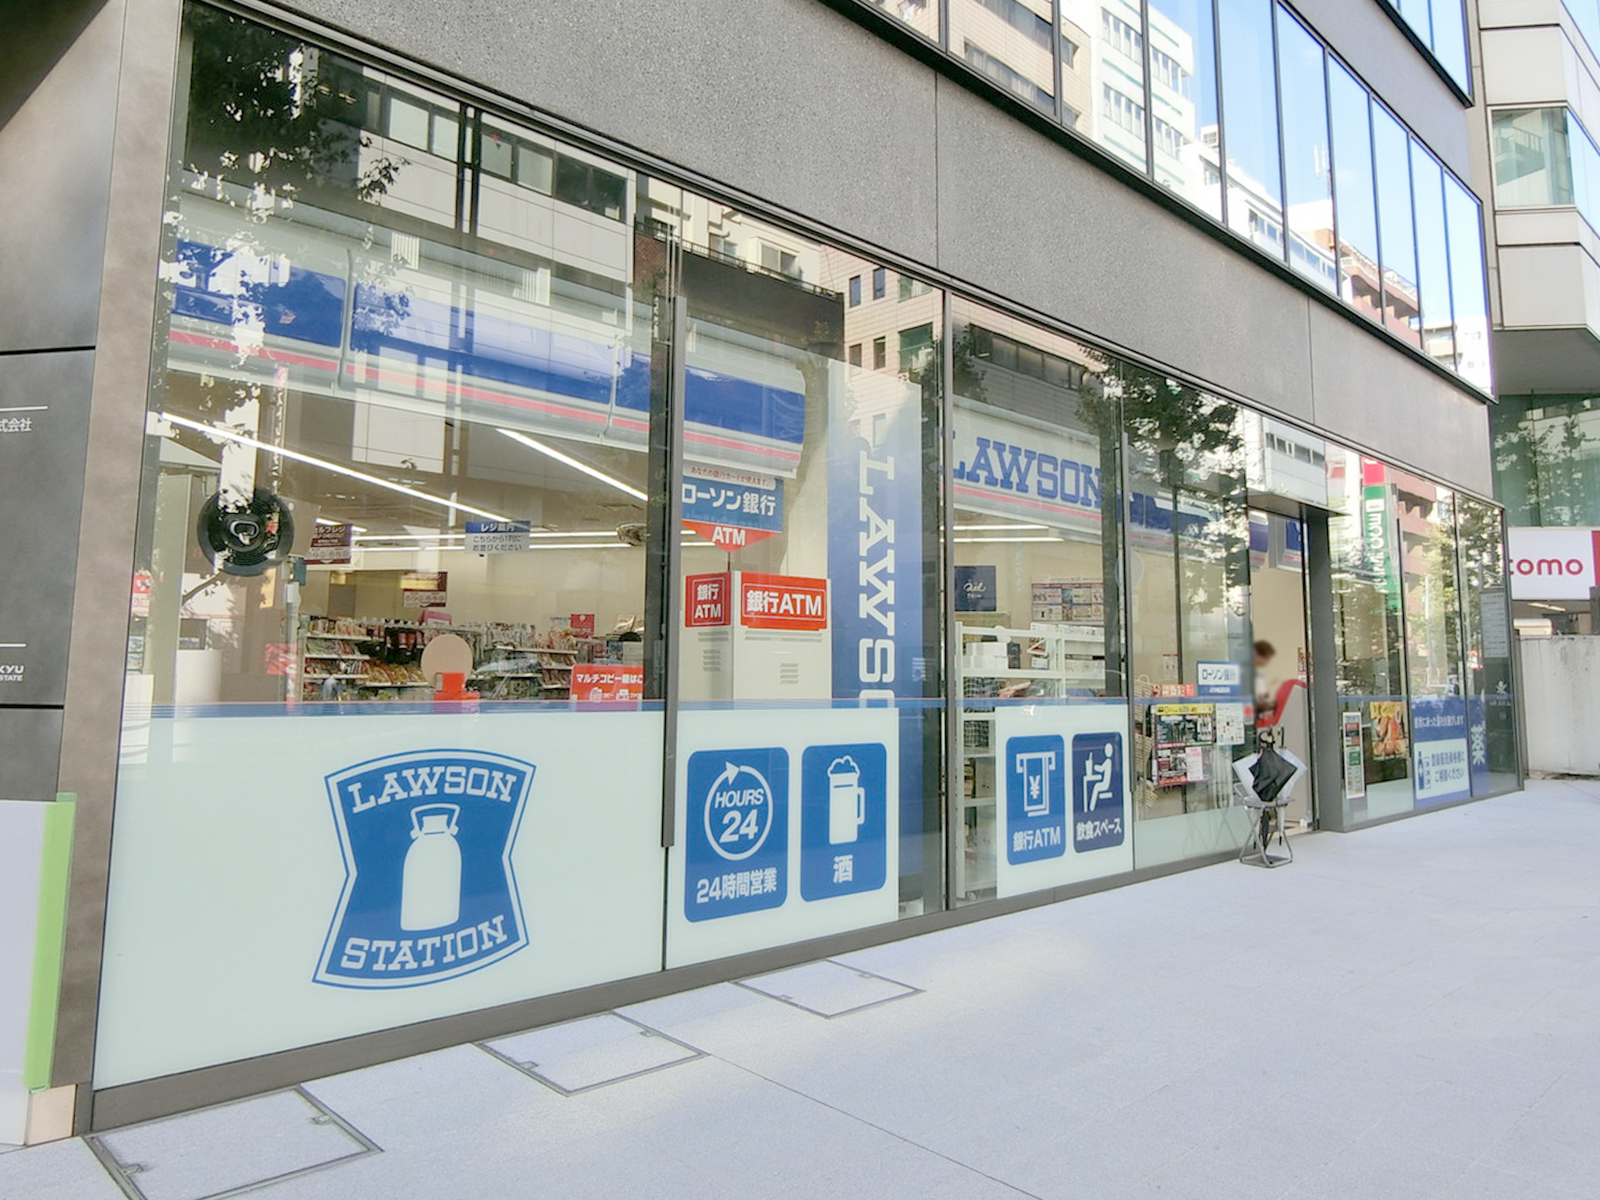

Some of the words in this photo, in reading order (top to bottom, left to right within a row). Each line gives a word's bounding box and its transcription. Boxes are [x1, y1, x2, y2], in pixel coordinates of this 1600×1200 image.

[953, 429, 1103, 508] AWSON
[681, 483, 776, 516] ローソン銀行
[481, 523, 515, 532] レジ案内
[712, 526, 746, 546] ATM
[697, 583, 719, 600] 銀行
[746, 589, 822, 616] 銀行ATM
[694, 603, 722, 619] ATM
[348, 765, 517, 814] LAWSON
[714, 788, 764, 809] HOURS
[719, 809, 759, 843] 24
[1013, 826, 1060, 852] 銀行ATM
[1076, 818, 1122, 840] 飲食スペース
[833, 854, 854, 883] 酒
[696, 867, 778, 904] 24時間営業
[340, 914, 508, 971] STATION
